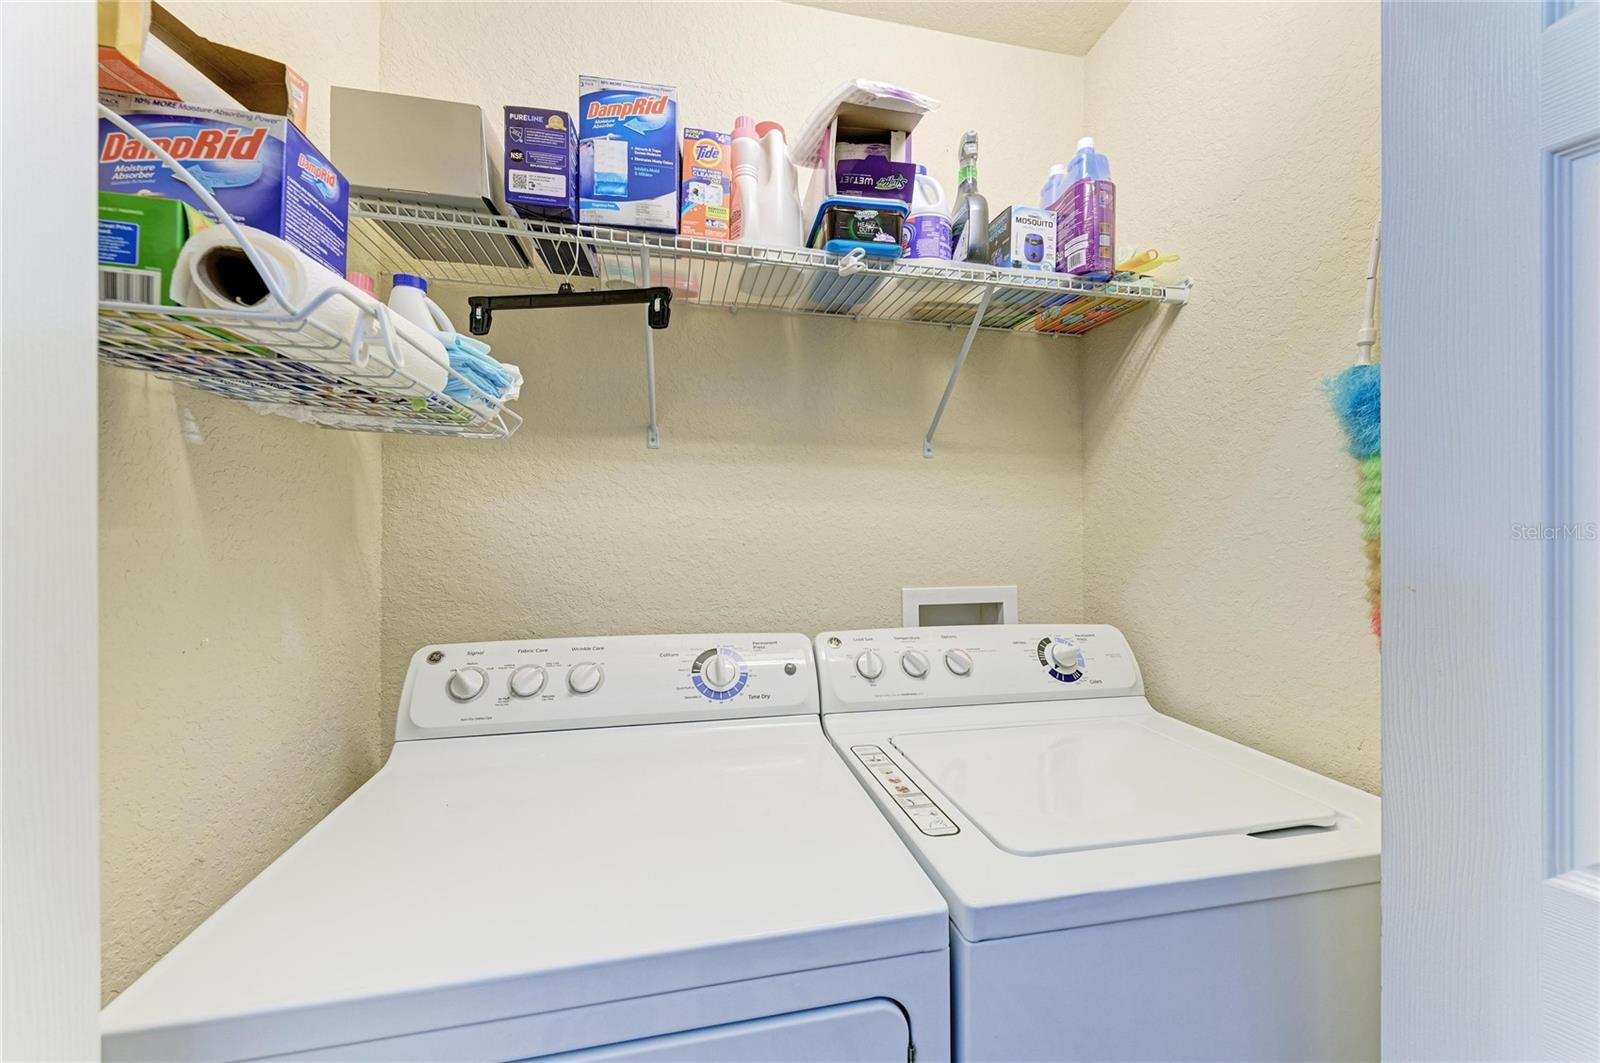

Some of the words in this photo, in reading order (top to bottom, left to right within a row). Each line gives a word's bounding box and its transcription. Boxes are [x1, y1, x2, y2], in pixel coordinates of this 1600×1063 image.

[152, 99, 176, 109] MORE
[178, 100, 212, 114] Moisture
[213, 108, 253, 122] Absorbing
[587, 95, 669, 120] DampRid
[509, 113, 544, 122] PURELINE
[696, 145, 720, 160] Tide
[114, 164, 156, 172] Moisture
[297, 152, 337, 189] DampRid
[111, 171, 155, 181] Absorber
[840, 176, 874, 185] WETJET
[1015, 216, 1054, 228] MOSQUITO
